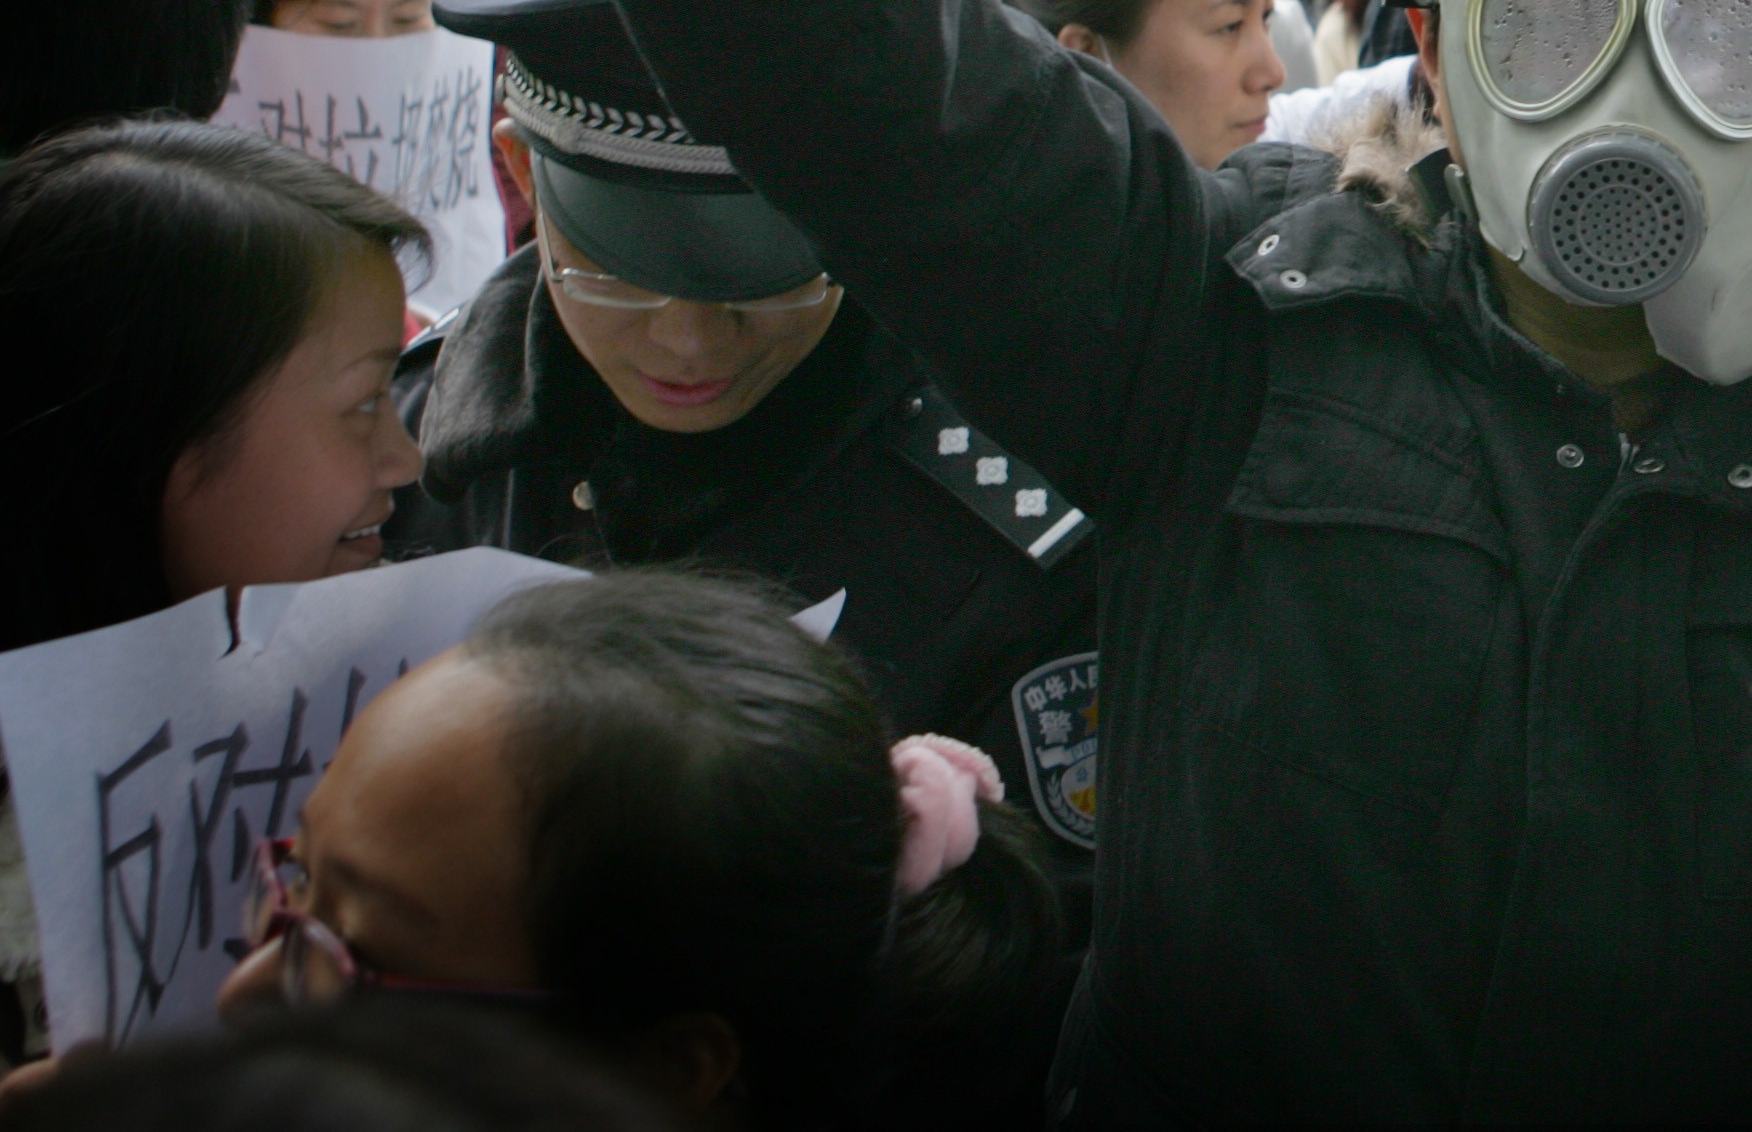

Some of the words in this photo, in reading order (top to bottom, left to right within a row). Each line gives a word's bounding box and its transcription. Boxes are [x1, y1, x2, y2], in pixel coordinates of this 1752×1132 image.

[224, 65, 482, 216] 对垃圾焚烧
[94, 656, 412, 1046] 反对
